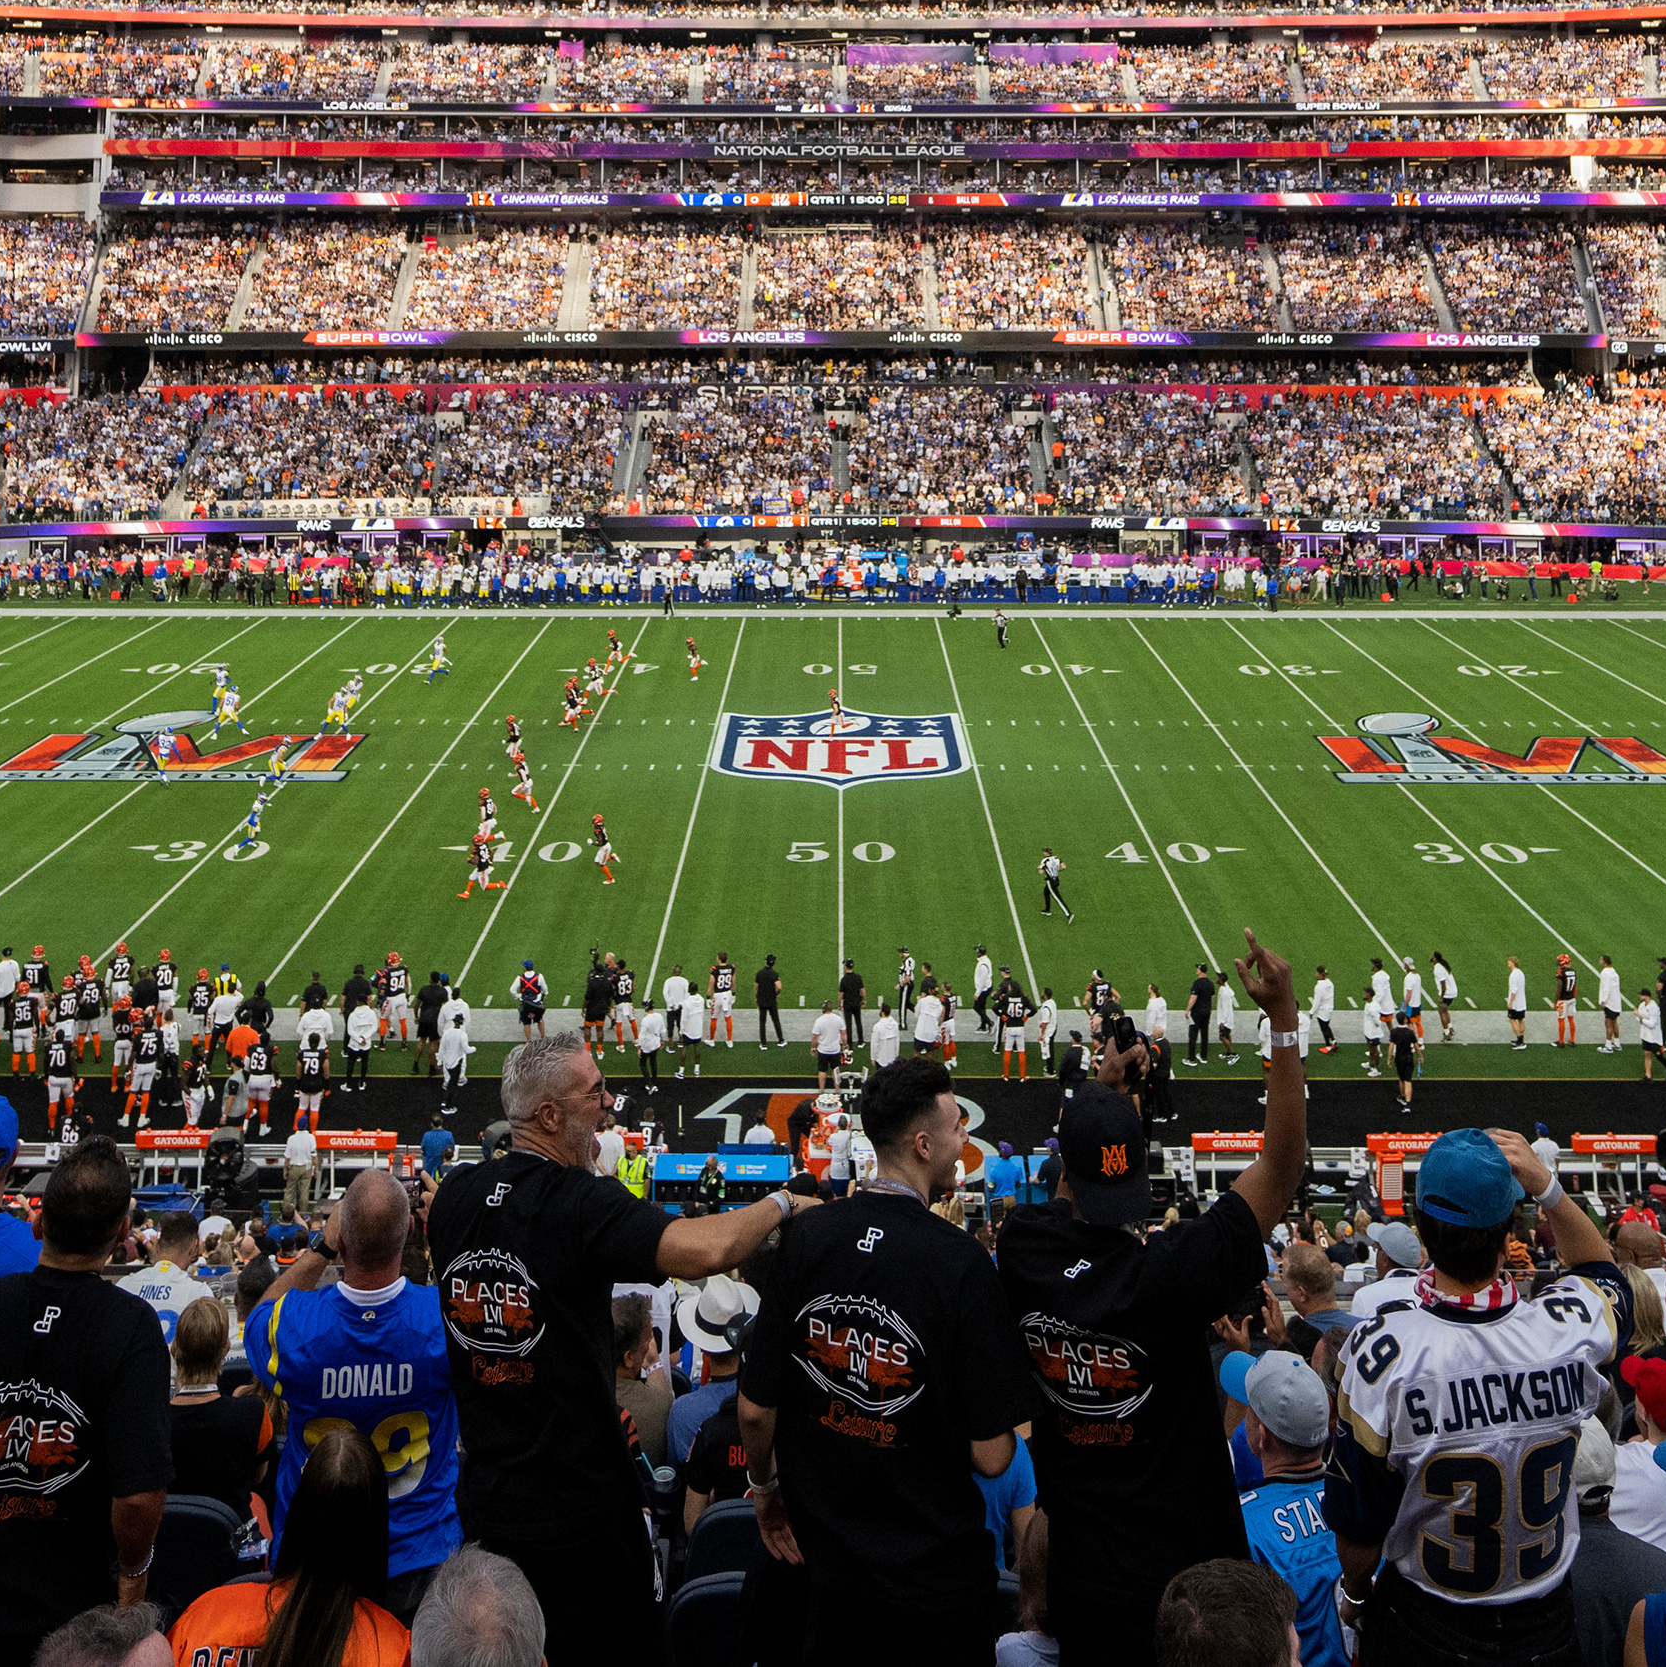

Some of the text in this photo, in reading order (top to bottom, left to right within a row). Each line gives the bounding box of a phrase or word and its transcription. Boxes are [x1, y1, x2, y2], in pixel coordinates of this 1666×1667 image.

[349, 101, 410, 111] ANGELES
[713, 145, 966, 156] NATIONAL FOOTBALL LEAGUE
[202, 193, 286, 204] ANGELES RAMS
[501, 194, 609, 205] CINCINNATI BENGALS
[849, 194, 885, 205] 15:00
[1120, 195, 1200, 205] ANGELES RAMS
[1427, 194, 1541, 205] CINCINNATI BENGALS
[188, 334, 223, 345] CISCO
[315, 332, 428, 344] SUPER BOWL
[564, 333, 598, 343] CISCO
[698, 333, 806, 343] LOS ANGELES
[929, 332, 963, 343] CISCO
[1065, 332, 1176, 344] SUPER BOWL
[1298, 334, 1334, 345] CISCO
[1426, 335, 1541, 347] LOS ANGELES
[31, 341, 52, 352] LVI
[296, 519, 331, 533] RAMS
[528, 516, 585, 529] BENGALS
[1091, 517, 1125, 529] RAMS
[1322, 519, 1381, 533] BENGALS
[742, 738, 933, 772] NFL
[785, 840, 895, 865] 50
[1103, 840, 1211, 865] 40
[1412, 841, 1528, 865] 30
[389, 975, 406, 992] 94
[617, 978, 633, 994] 83
[717, 974, 732, 989] 89
[15, 1006, 31, 1022] 96
[154, 1136, 202, 1146] GATORADE
[450, 1277, 530, 1309] PLACES
[807, 1317, 909, 1367] PLACES
[1026, 1332, 1131, 1371] PLACES
[321, 1363, 414, 1399] DONALD
[5, 1437, 30, 1463] LVI
[1418, 1433, 1581, 1597] 39
